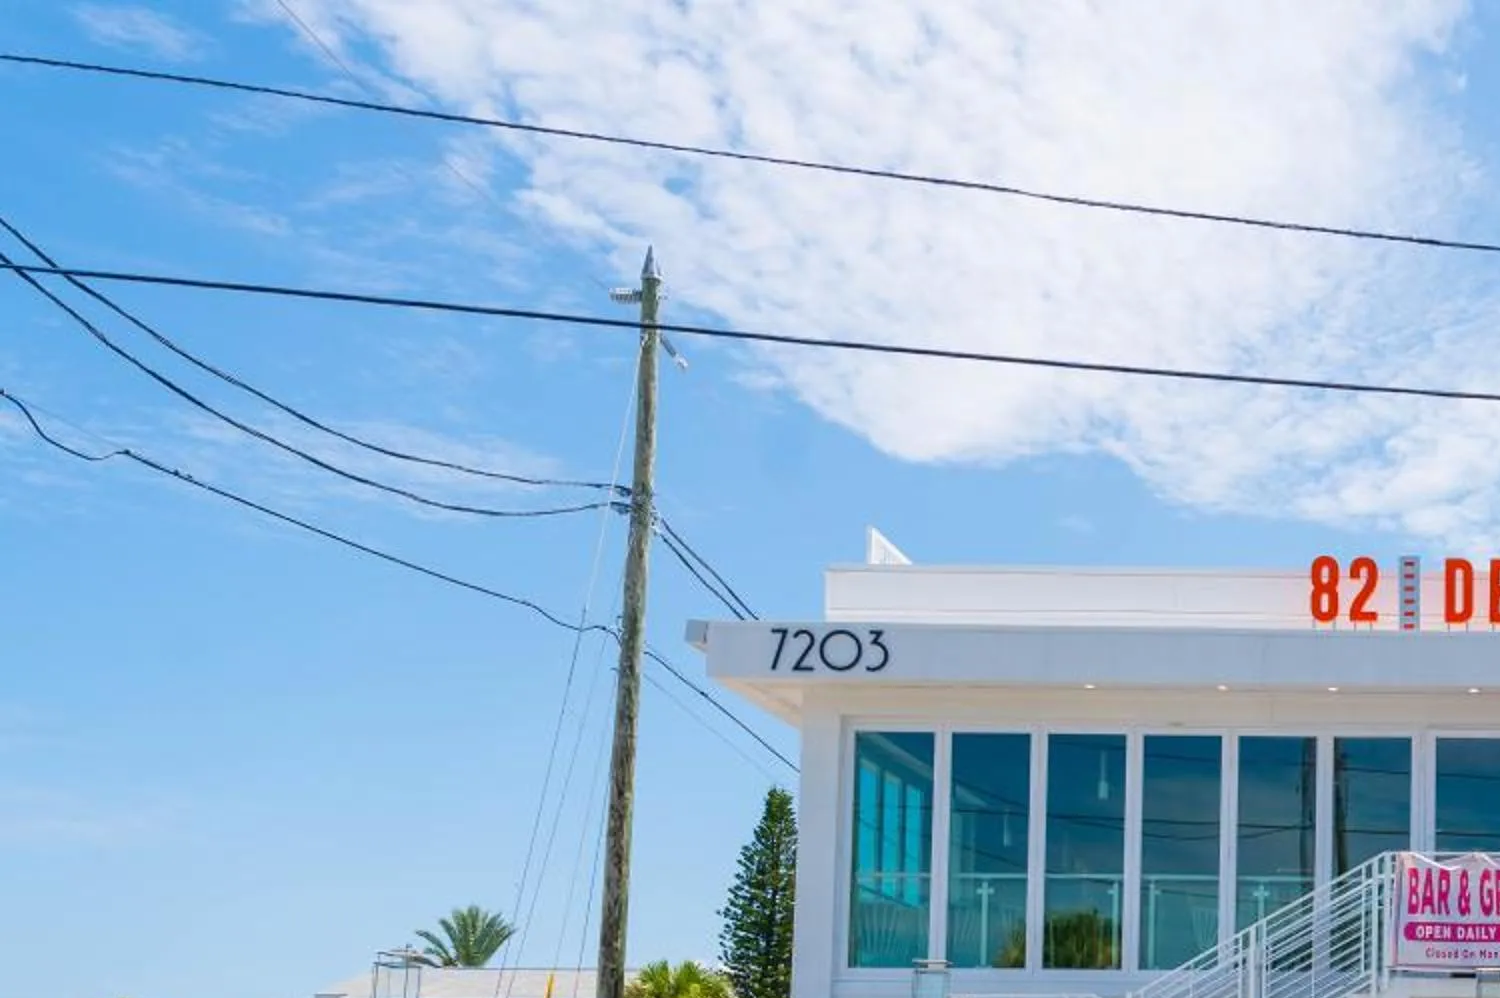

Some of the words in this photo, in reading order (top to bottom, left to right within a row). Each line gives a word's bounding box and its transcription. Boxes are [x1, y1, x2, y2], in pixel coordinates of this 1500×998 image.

[1310, 555, 1379, 622] 82
[770, 628, 889, 672] 7203
[1407, 867, 1451, 915] BAR
[1457, 869, 1471, 916] &
[1415, 925, 1451, 940] OPEN
[1457, 926, 1497, 940] DAILY
[1425, 947, 1459, 959] Closed
